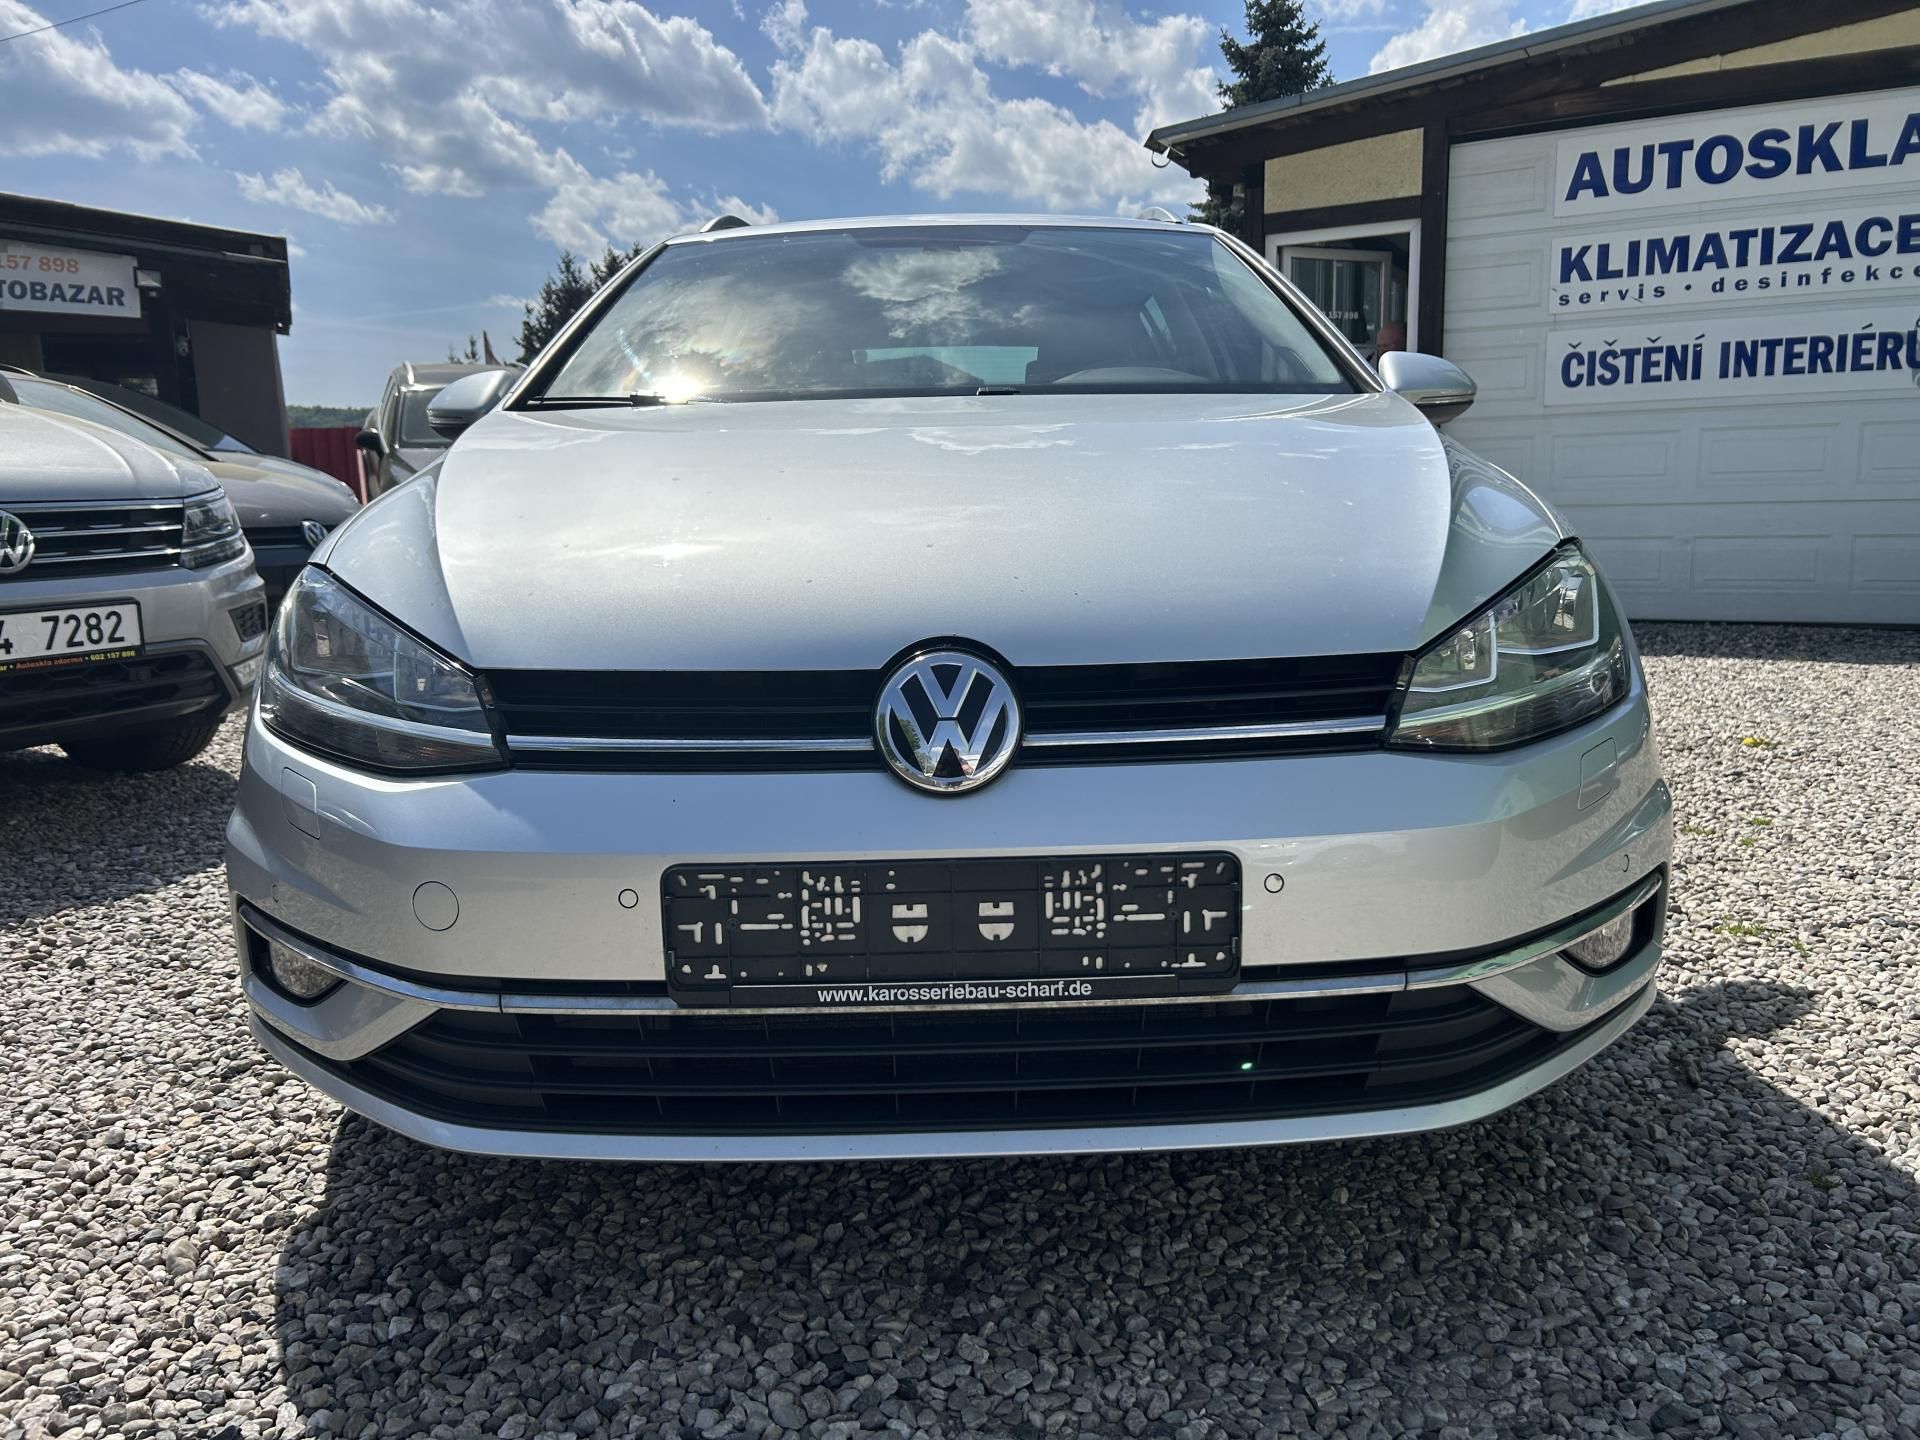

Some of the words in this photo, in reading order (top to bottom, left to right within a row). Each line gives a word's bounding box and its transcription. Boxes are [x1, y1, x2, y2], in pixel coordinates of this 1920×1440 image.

[1565, 113, 1920, 201] AUTOSKLA
[38, 256, 79, 273] 898
[1559, 213, 1920, 284] KLIMATIZACE
[1558, 283, 1665, 306] servis
[1561, 333, 1705, 388] ČIŠTĚNÍ
[41, 610, 125, 650] 7282
[817, 980, 1092, 1002] www.karosseriebau-scharf.de
